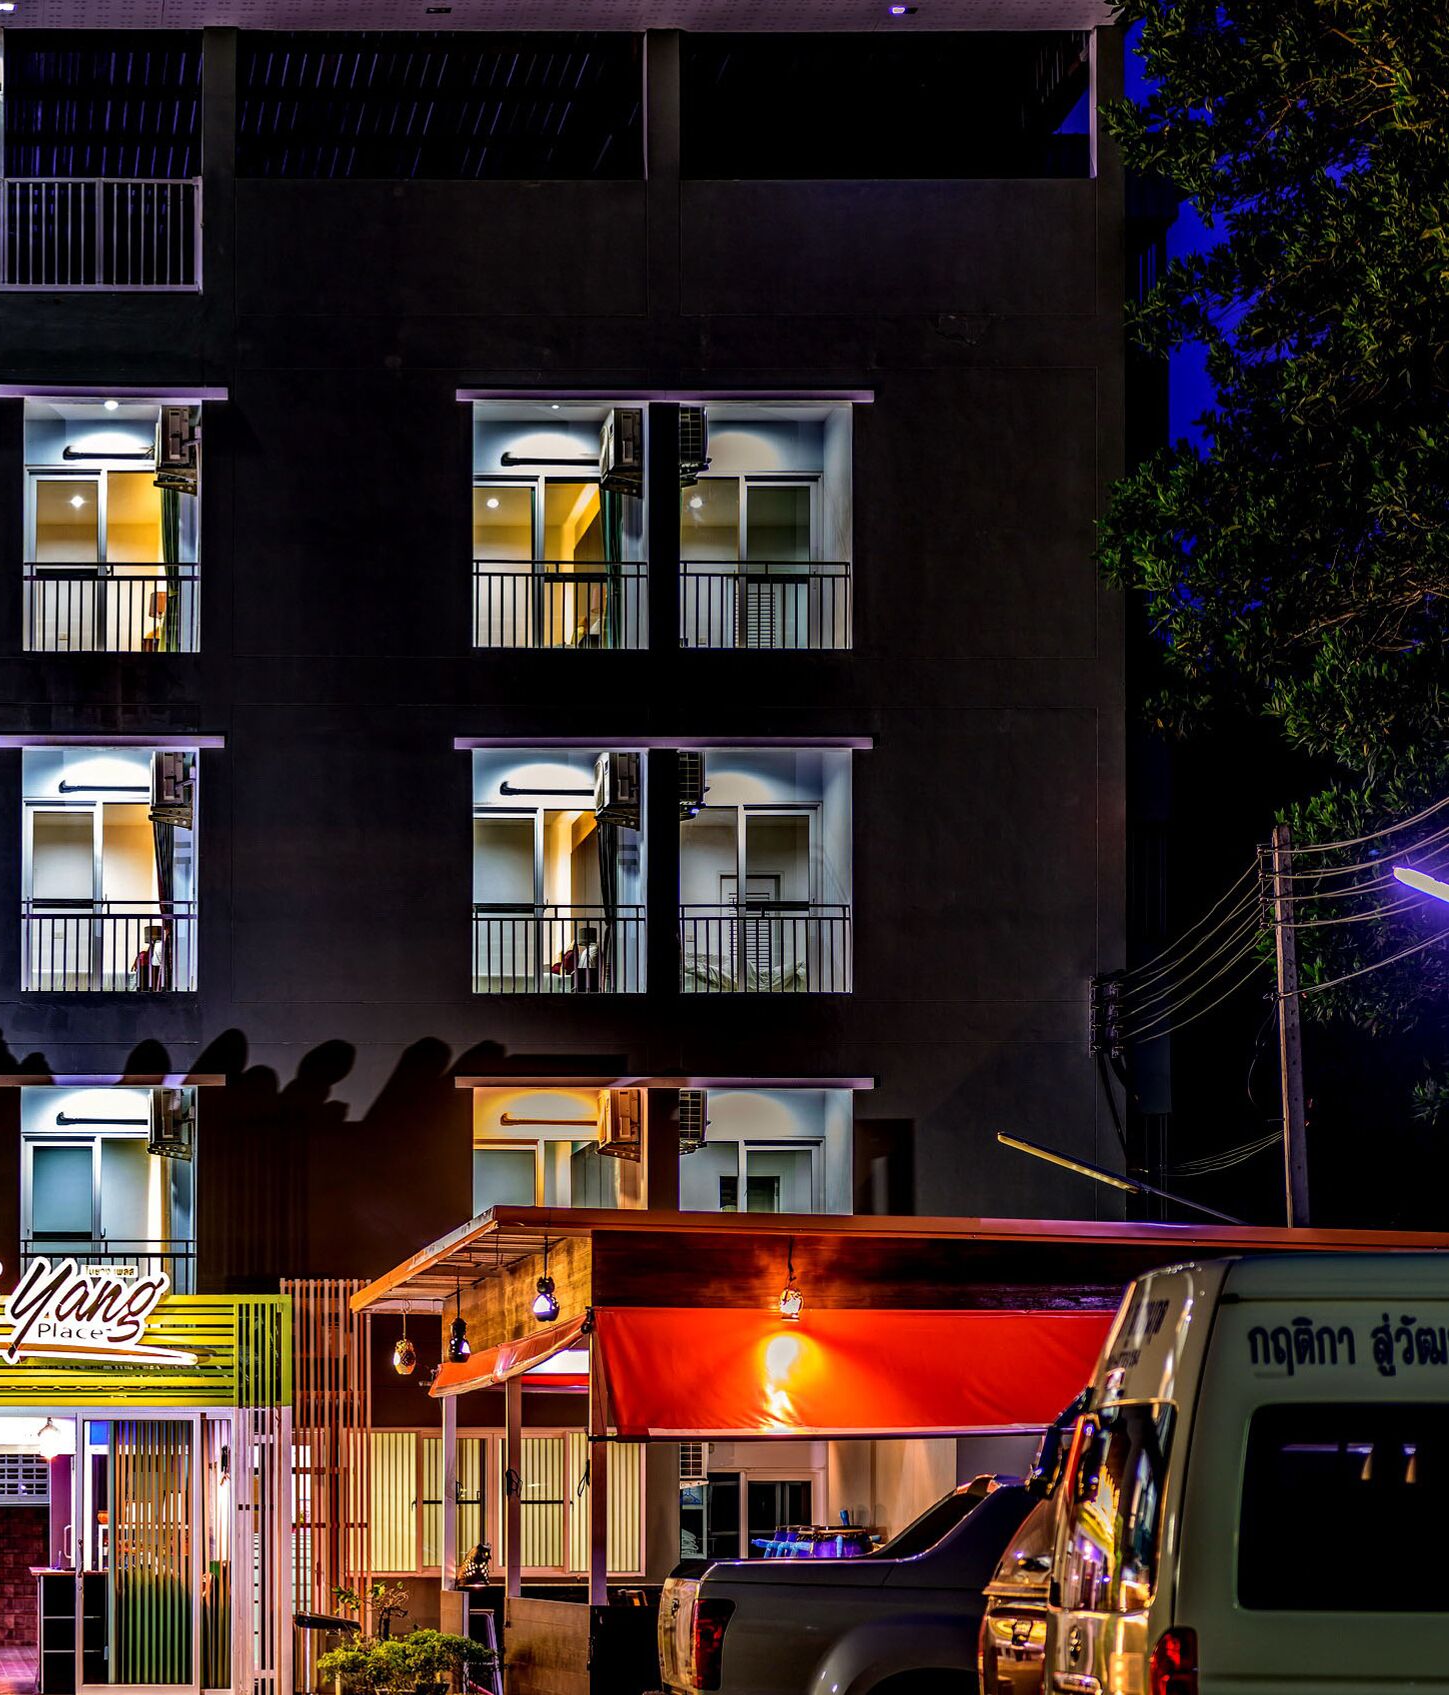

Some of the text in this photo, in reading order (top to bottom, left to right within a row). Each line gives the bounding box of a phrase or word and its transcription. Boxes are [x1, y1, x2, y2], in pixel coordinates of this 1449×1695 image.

[11, 1259, 165, 1356] Yang
[37, 1322, 104, 1340] Place
[1247, 1315, 1356, 1377] กฤติกา
[1371, 1312, 1449, 1377] สู่วัฒ
